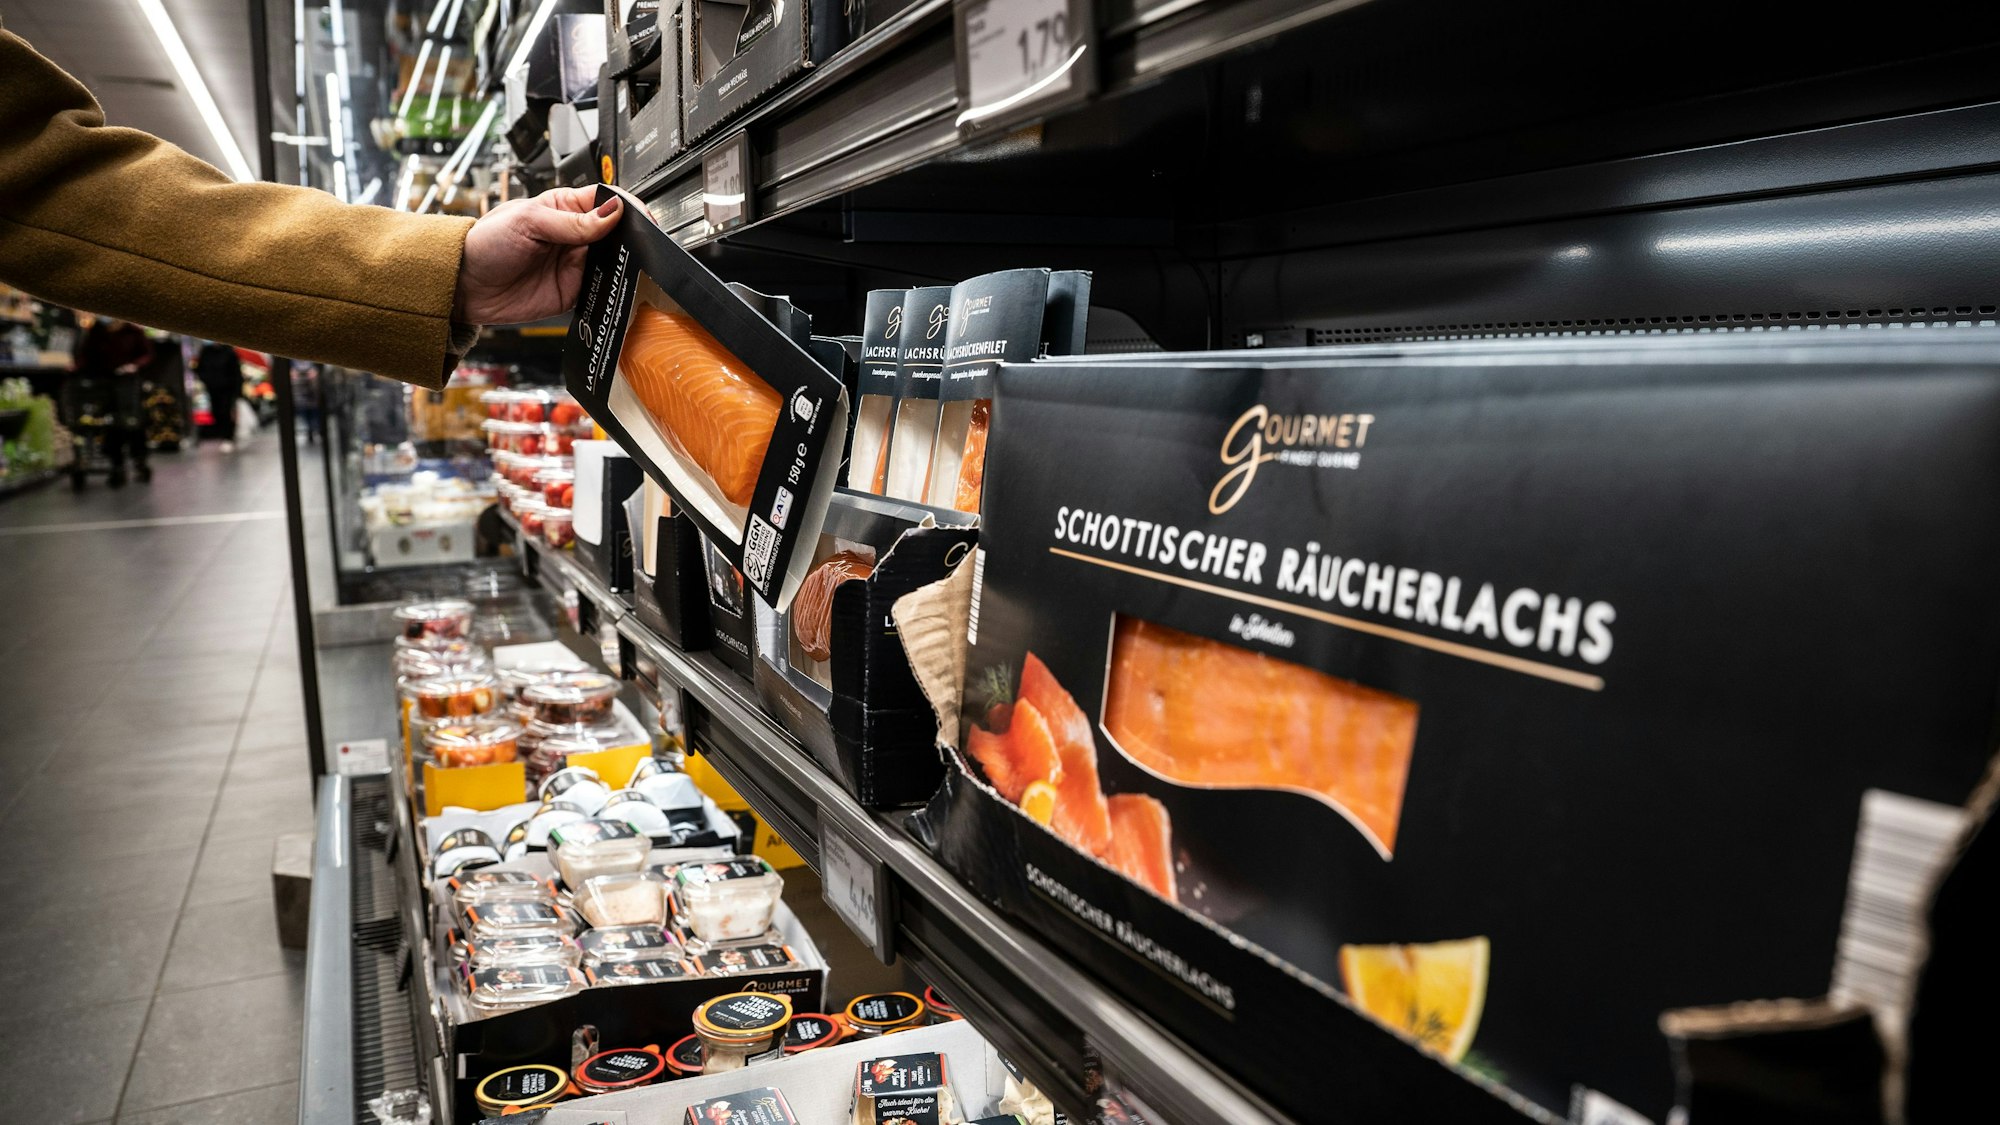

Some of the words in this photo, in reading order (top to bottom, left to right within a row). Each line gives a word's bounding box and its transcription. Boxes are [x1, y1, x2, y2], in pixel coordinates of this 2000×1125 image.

[586, 244, 628, 392] LACHSRÜCKENFILET
[788, 465, 801, 485] 150
[1208, 404, 1375, 515] GOURMET
[749, 520, 762, 551] GGN
[755, 525, 767, 556] CERTIFIED
[759, 530, 771, 559] FARMING
[1054, 505, 1267, 585] SCHOTTISCHER
[1276, 542, 1617, 665] RÄUCHERLACHS
[1026, 862, 1114, 935] SCHOTTISCHER
[1115, 919, 1236, 1010] RÄUCHERLACHS
